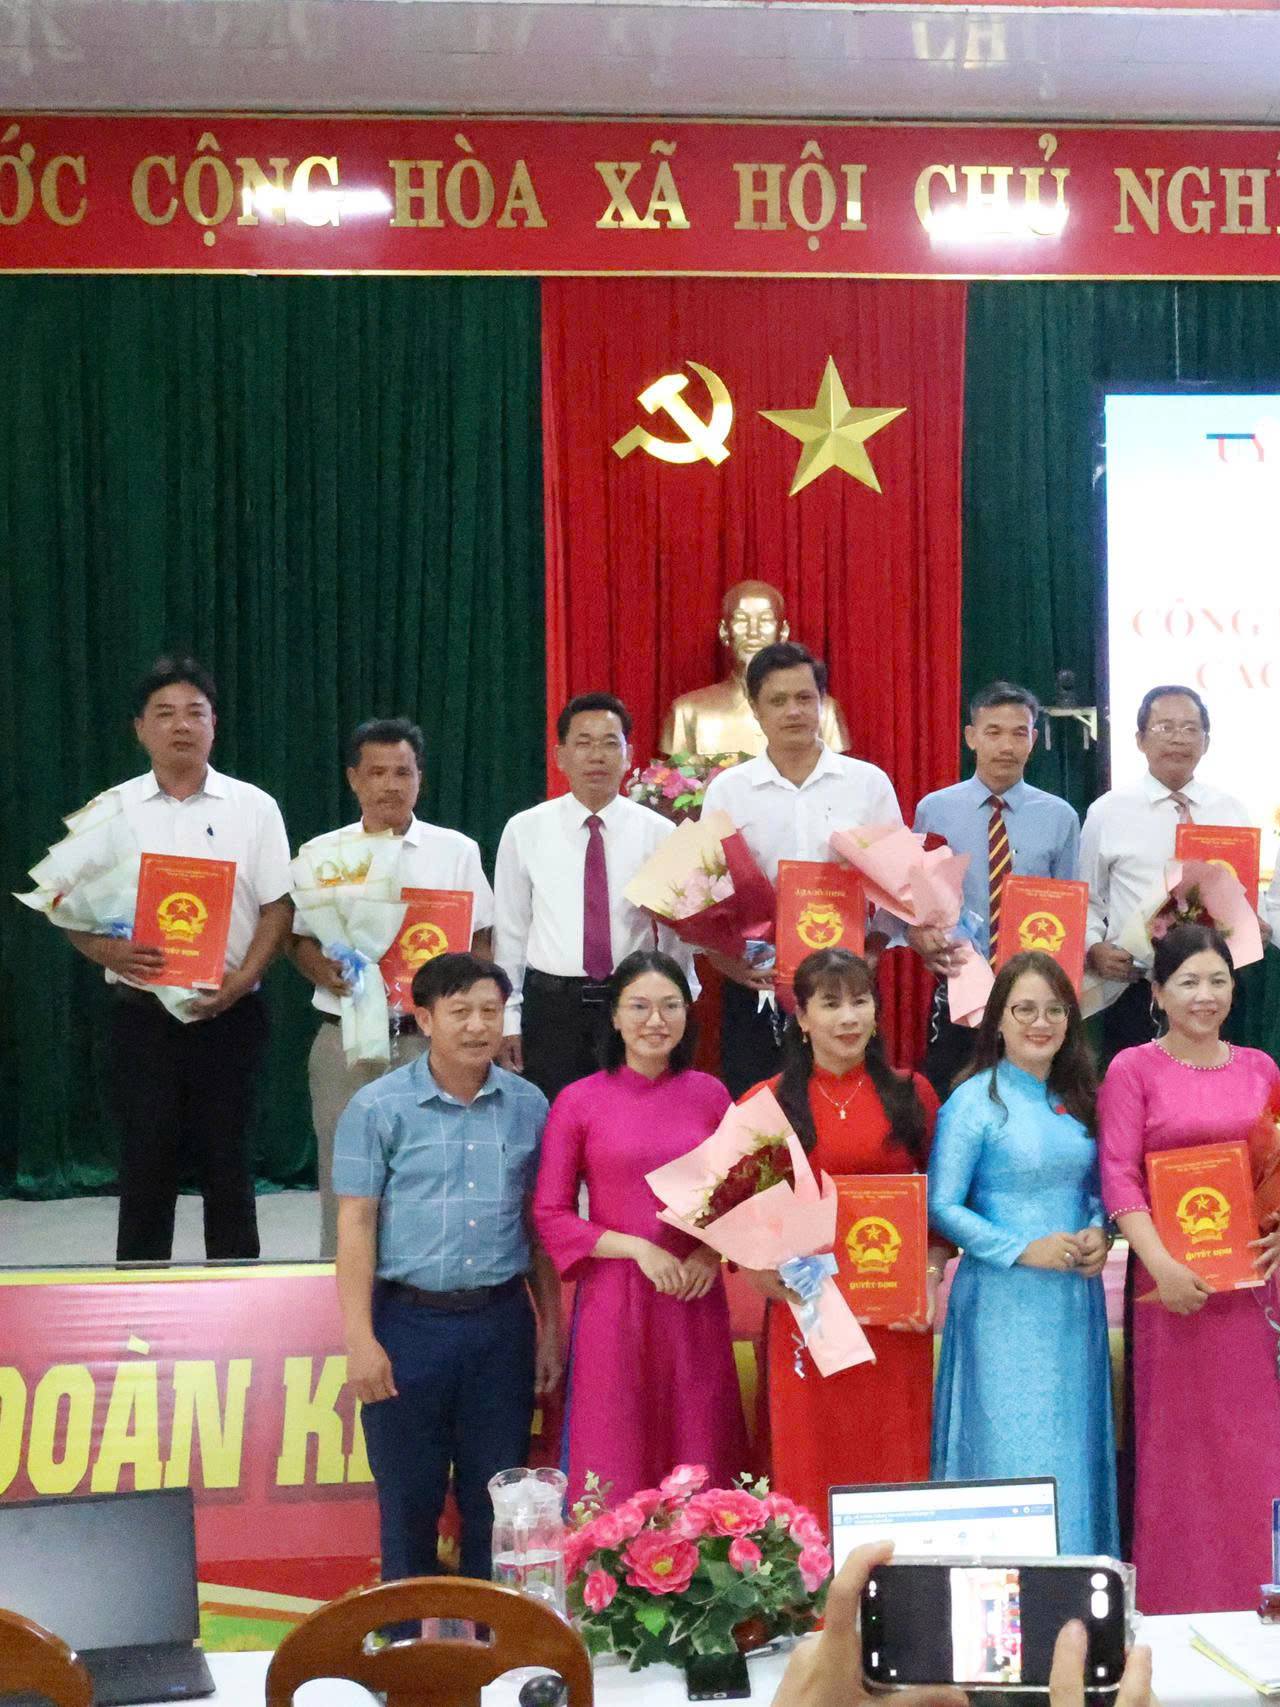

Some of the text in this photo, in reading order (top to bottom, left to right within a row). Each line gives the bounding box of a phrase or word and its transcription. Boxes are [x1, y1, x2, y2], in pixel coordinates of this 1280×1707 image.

[132, 132, 343, 247] CỘNG
[390, 133, 547, 228] HÒA
[595, 140, 691, 230] XÃ
[733, 140, 866, 252] HỘI
[914, 132, 1071, 237] CHỦ
